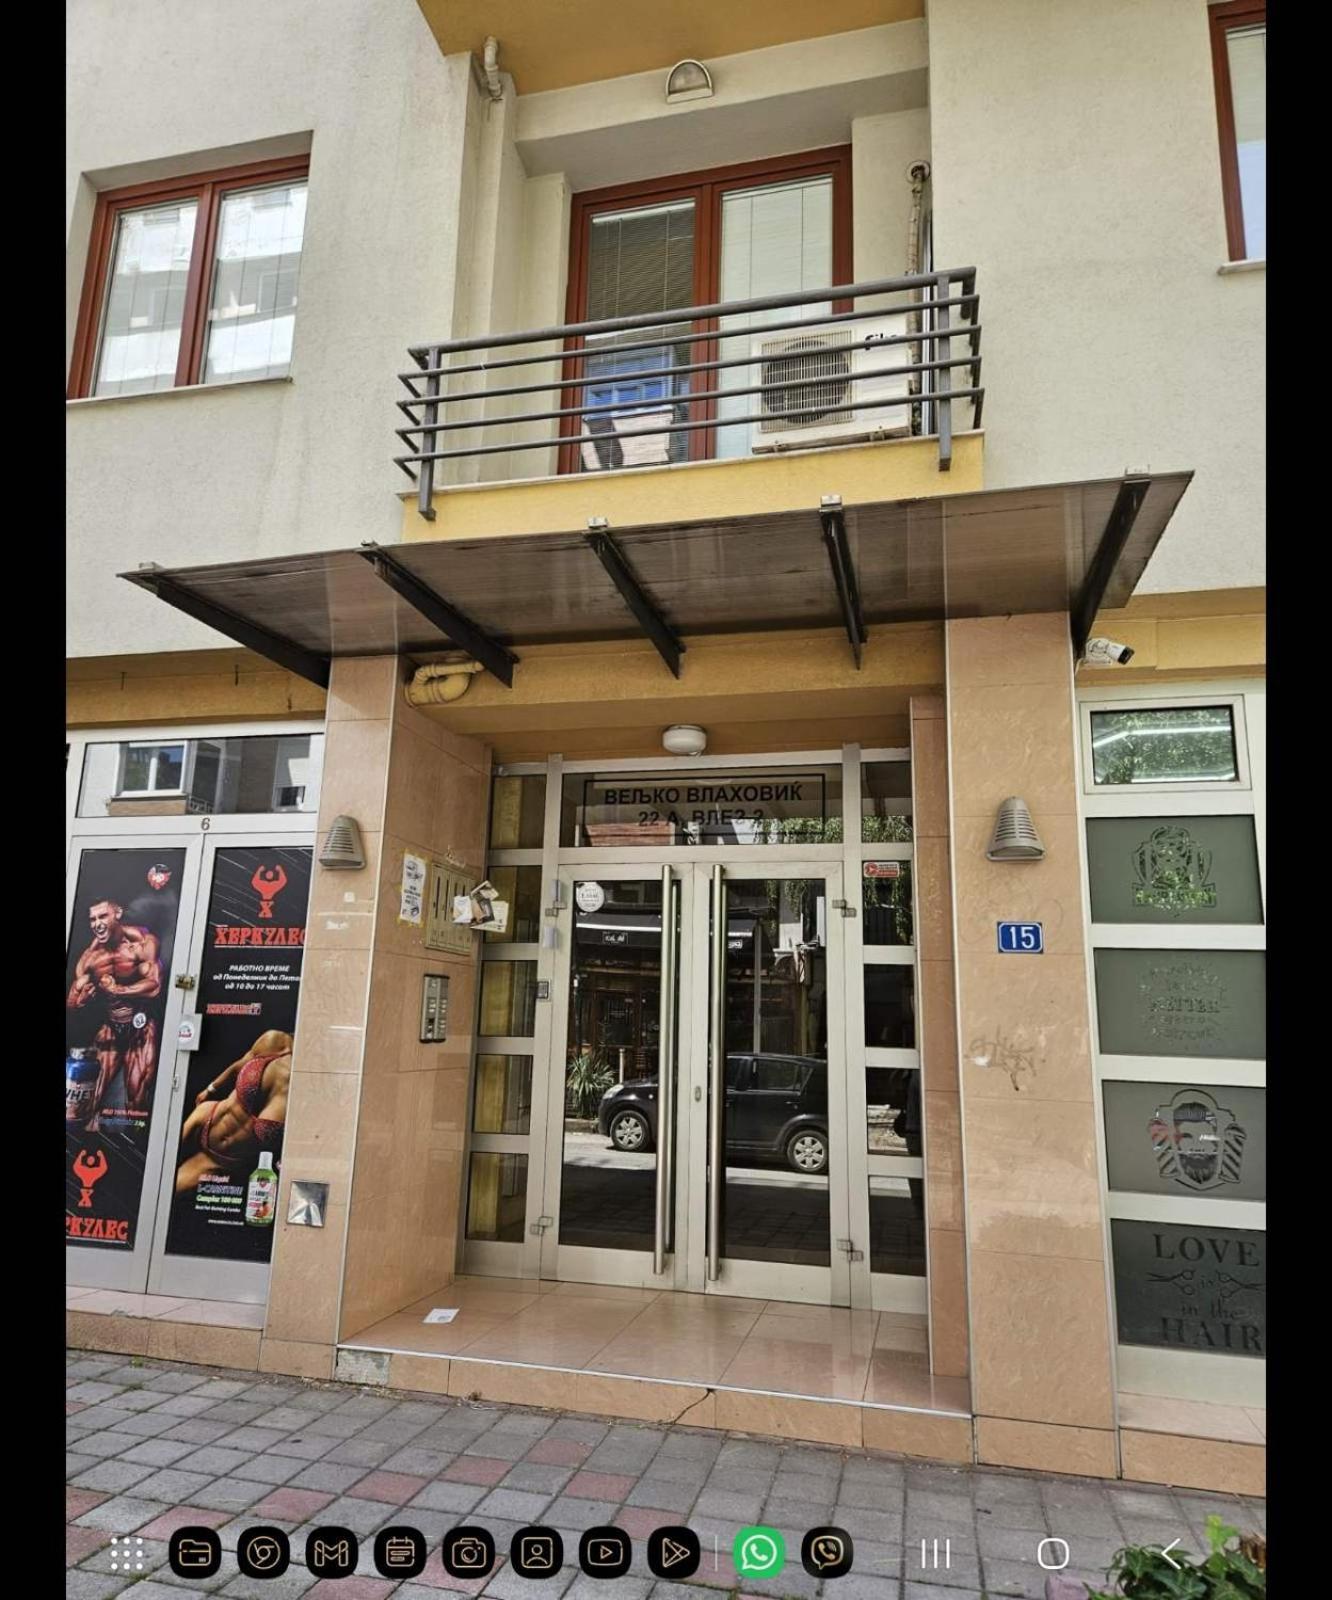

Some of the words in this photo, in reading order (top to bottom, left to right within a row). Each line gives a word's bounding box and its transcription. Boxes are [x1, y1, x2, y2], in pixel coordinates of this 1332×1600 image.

[200, 817, 211, 831] 6
[638, 811, 660, 827] 22
[1008, 926, 1036, 949] 15
[228, 964, 264, 972] РАБОТНО
[264, 965, 290, 973] ВРЕМЕ
[1153, 1233, 1260, 1267] LOVE
[1160, 1317, 1263, 1352] HAIR
